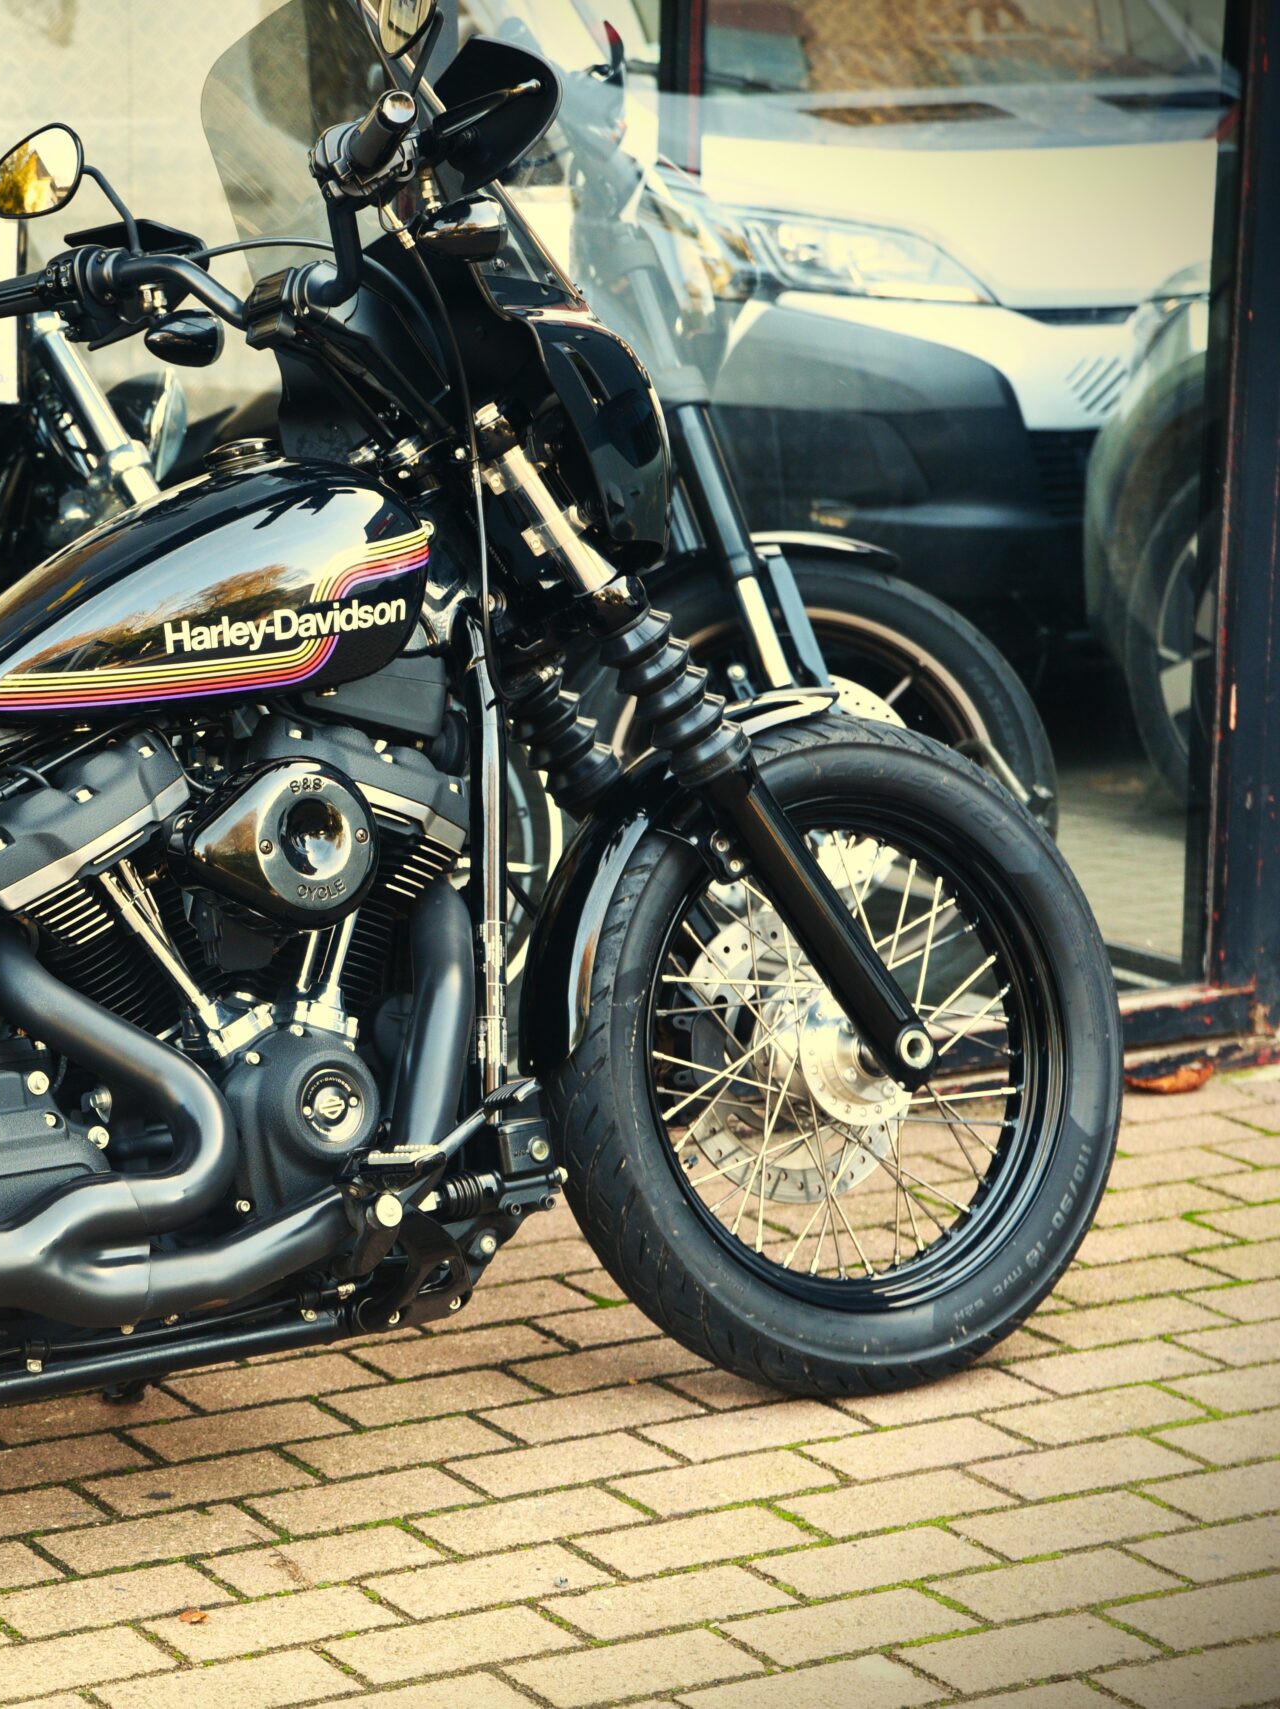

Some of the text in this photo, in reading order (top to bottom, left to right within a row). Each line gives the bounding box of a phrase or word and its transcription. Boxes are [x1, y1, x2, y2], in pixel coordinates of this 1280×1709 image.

[164, 598, 406, 654] Harley-Davidson
[289, 777, 324, 795] S&S
[296, 879, 347, 901] CYCLE
